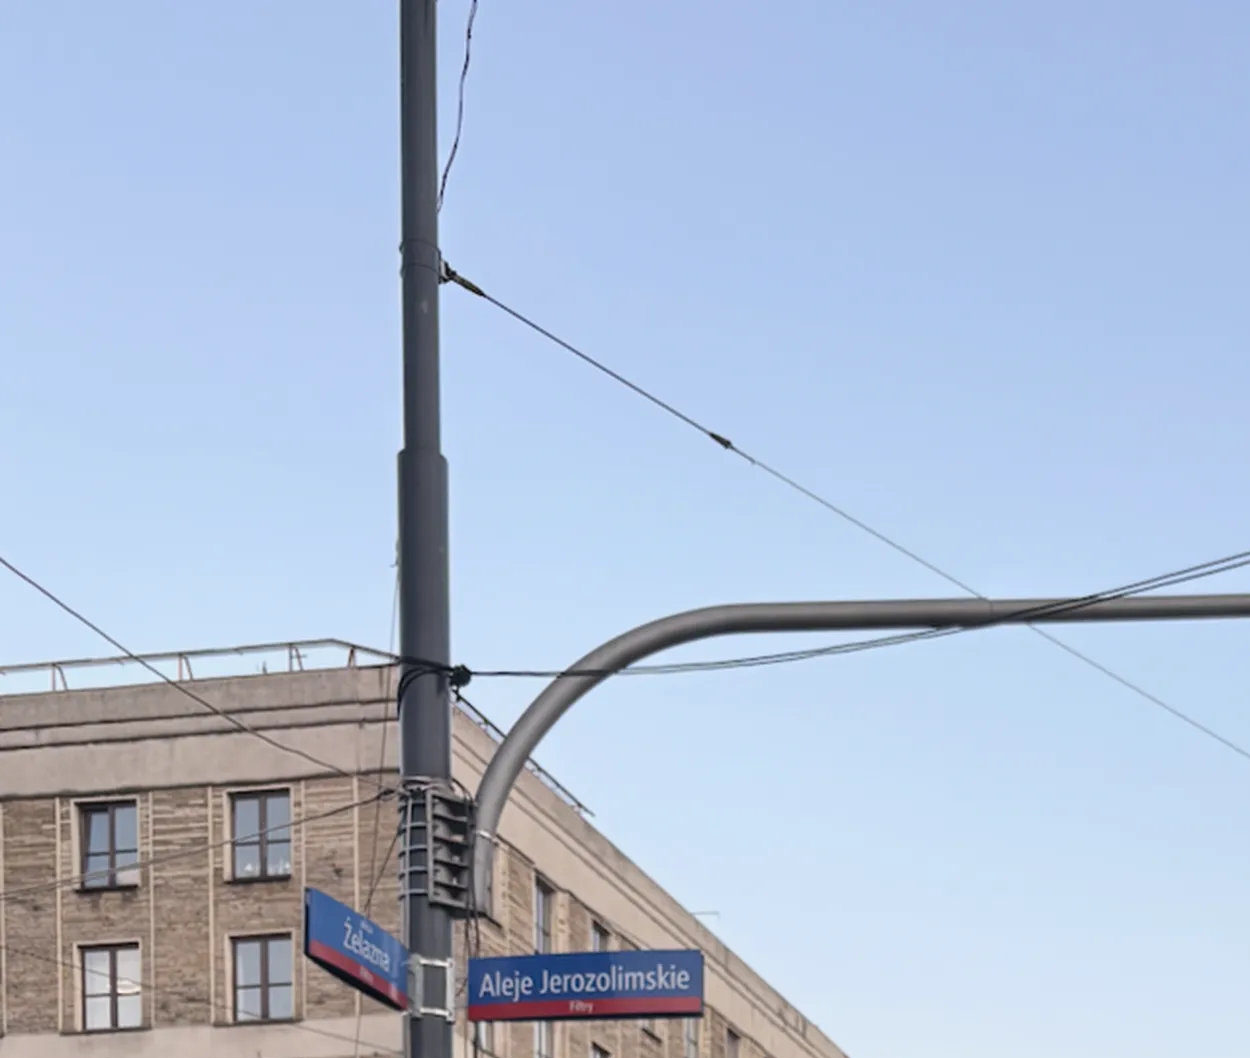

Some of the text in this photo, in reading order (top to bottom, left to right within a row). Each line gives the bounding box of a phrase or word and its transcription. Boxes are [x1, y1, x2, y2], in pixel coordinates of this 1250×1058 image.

[479, 964, 690, 1001] Aleje Jerozolimskie
[569, 1000, 593, 1014] Filtry
